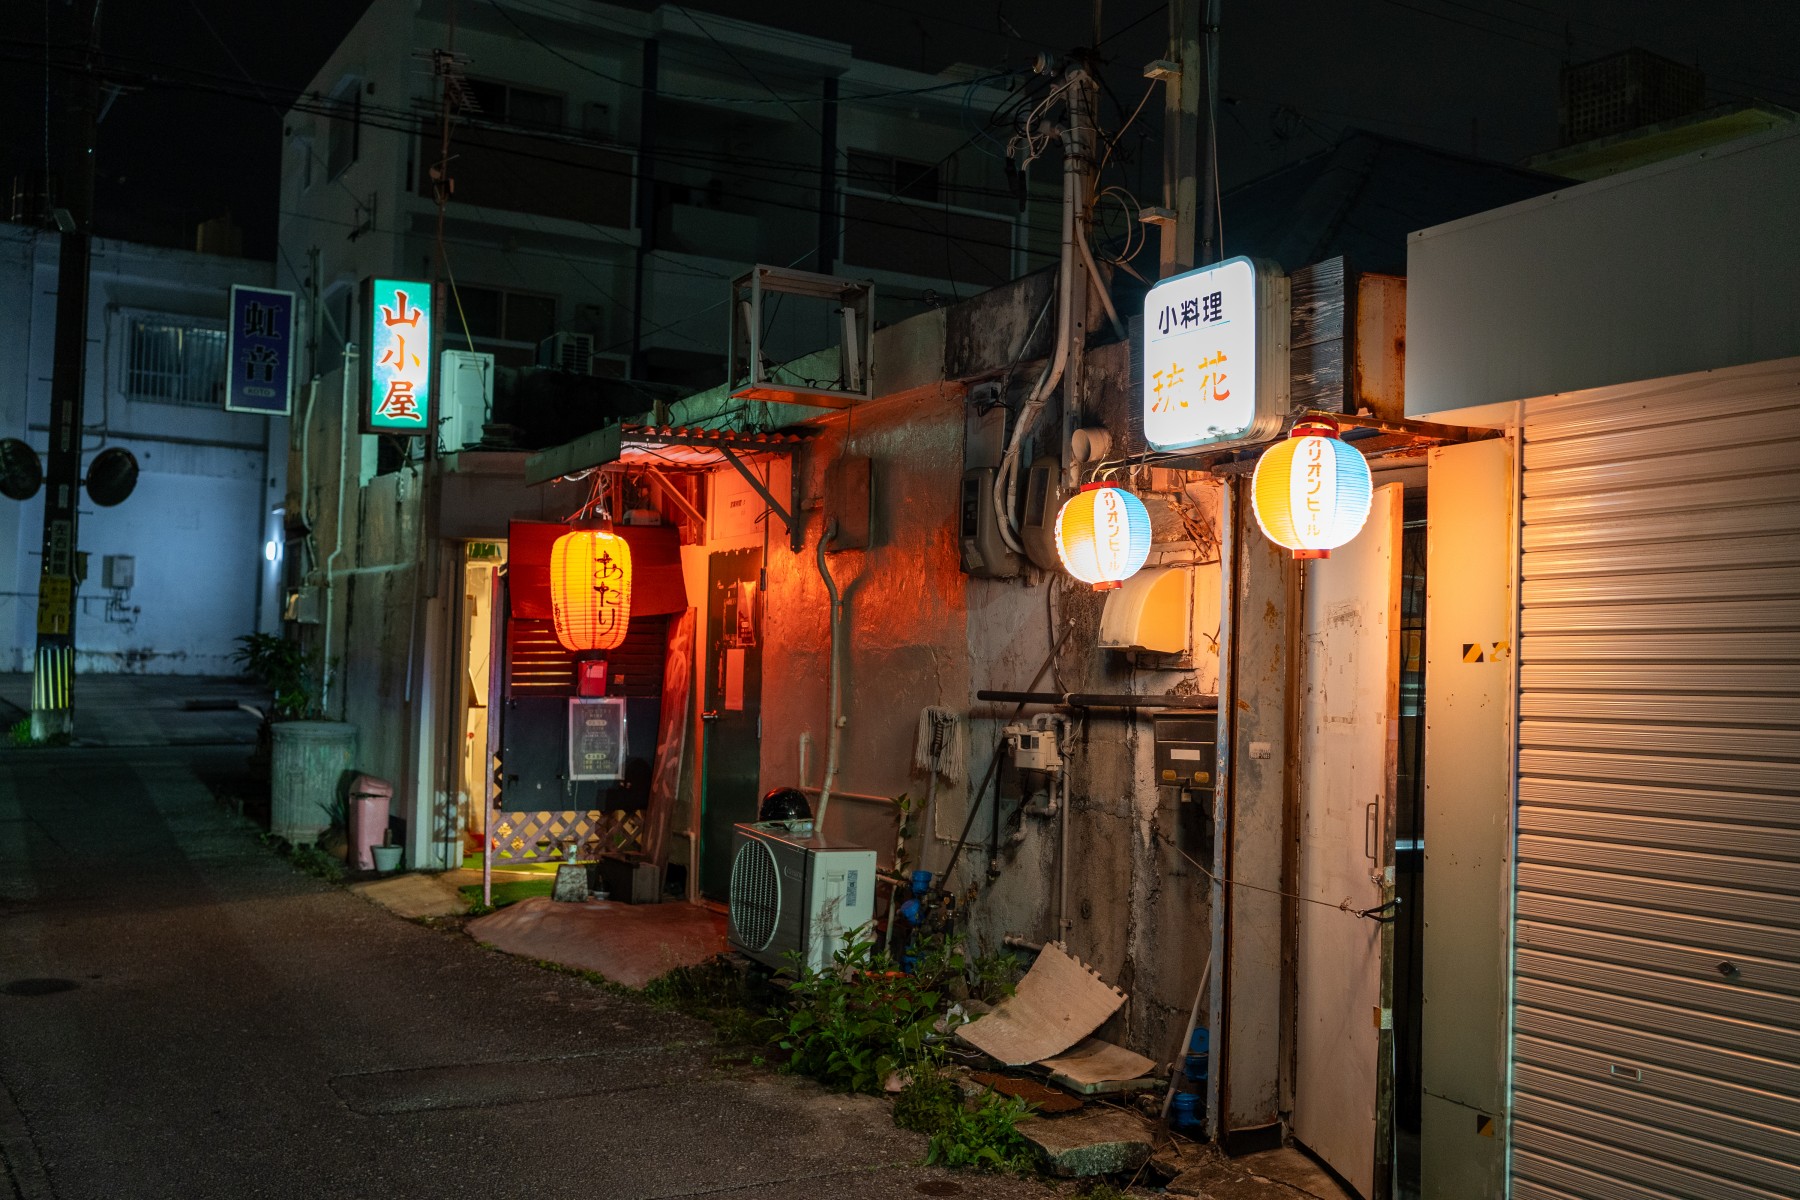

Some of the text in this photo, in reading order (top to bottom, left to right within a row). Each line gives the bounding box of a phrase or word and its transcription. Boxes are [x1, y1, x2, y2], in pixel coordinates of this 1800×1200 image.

[242, 300, 282, 383] 虹音
[1158, 290, 1223, 335] 小料理
[377, 290, 422, 421] 山小屋
[1151, 349, 1231, 413] 琉花
[593, 550, 624, 637] あたり
